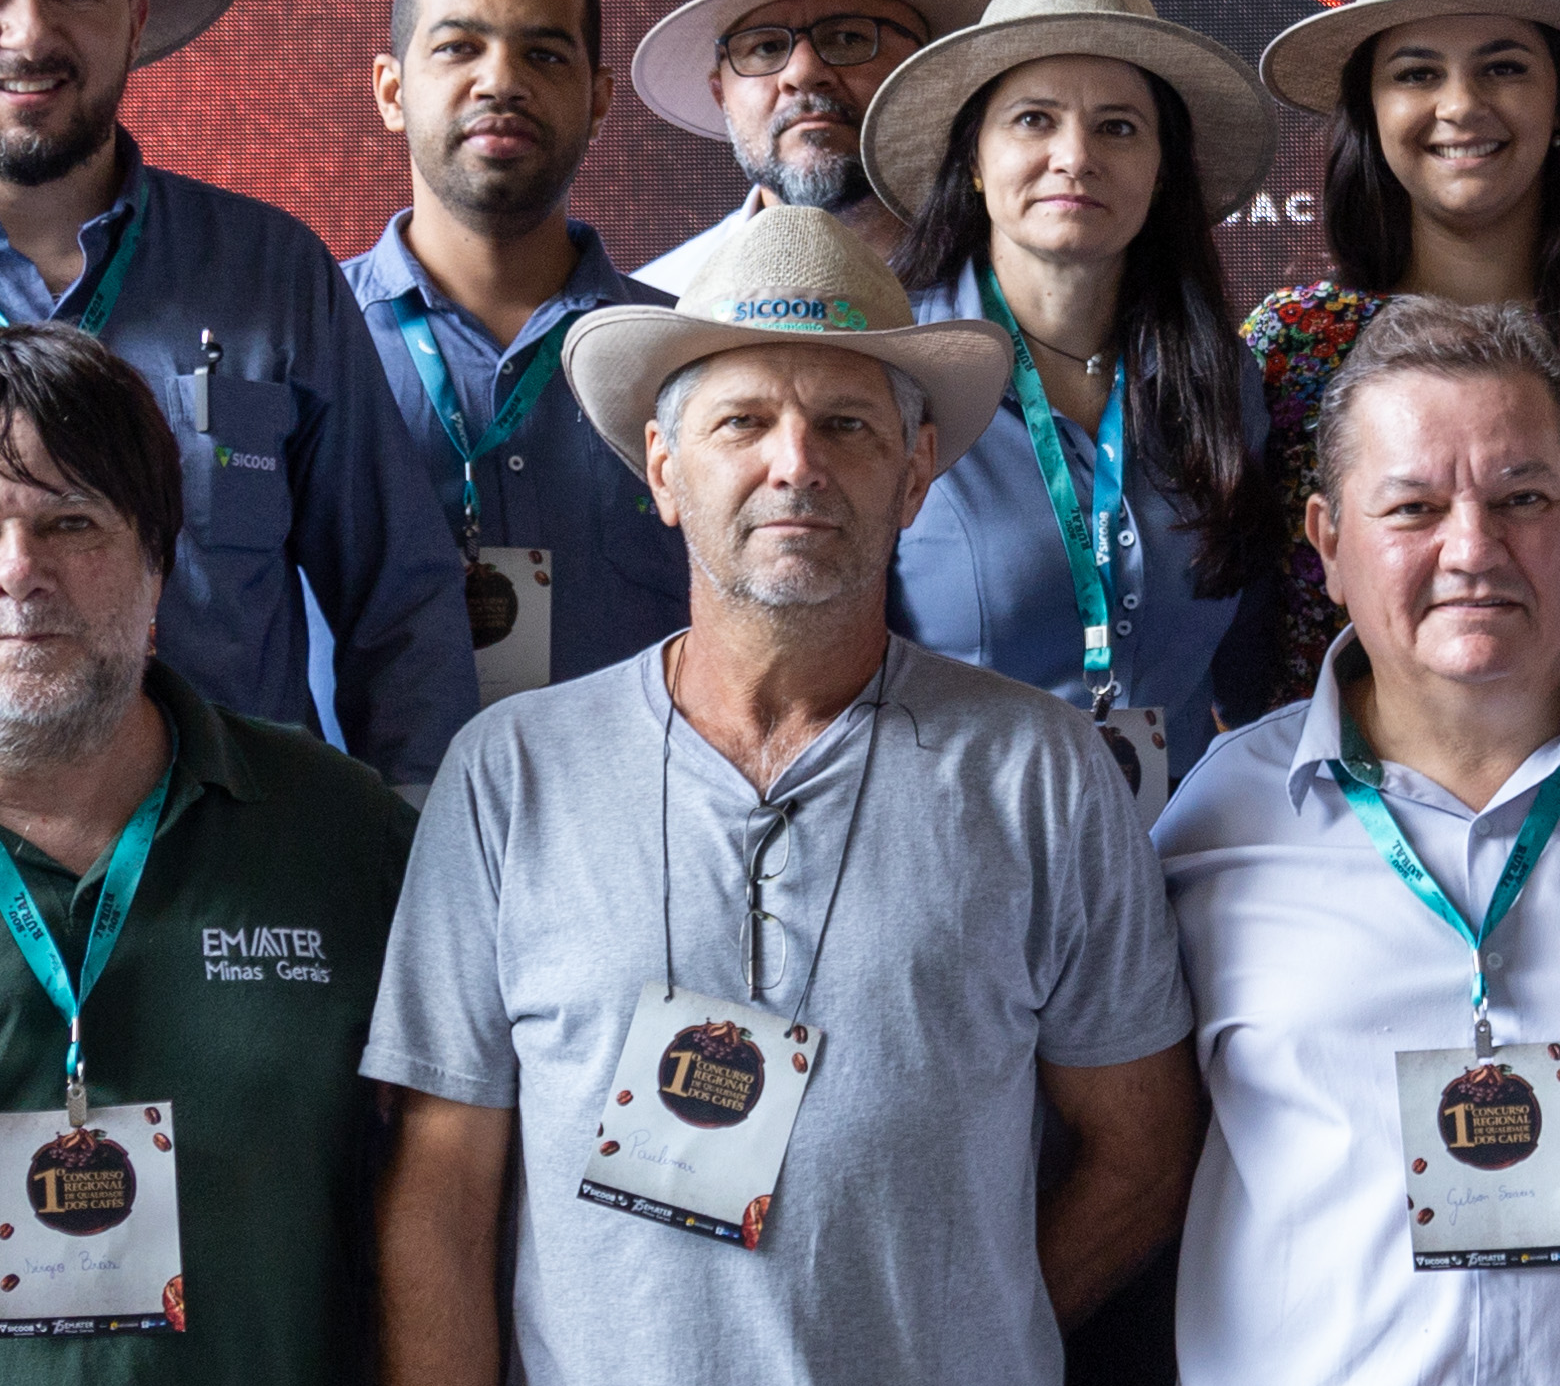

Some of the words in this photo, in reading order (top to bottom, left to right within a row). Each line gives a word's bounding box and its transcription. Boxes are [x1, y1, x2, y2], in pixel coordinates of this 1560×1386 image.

[734, 299, 827, 322] SICOOB
[232, 453, 276, 471] SICOOB
[1098, 511, 1110, 552] SICOOB
[1392, 840, 1424, 881] RURAL
[14, 891, 45, 941] RURAL
[203, 927, 326, 960] EMATER
[205, 960, 264, 981] Minas
[276, 961, 332, 984] Gerais
[693, 1070, 752, 1094] REGIONAL
[696, 1061, 755, 1084] CONCURSO
[689, 1088, 710, 1103] DOS
[711, 1093, 745, 1112] CAFÉS
[1471, 1105, 1530, 1117] CONCURSO
[1472, 1115, 1531, 1127] REGIONAL
[1473, 1134, 1496, 1145] DOS
[1498, 1131, 1531, 1144] CAFÉS
[63, 1171, 125, 1181] CONCURSO
[64, 1181, 125, 1192] REGIONAL
[64, 1201, 89, 1211] DOS
[90, 1198, 125, 1210] CAFÉS
